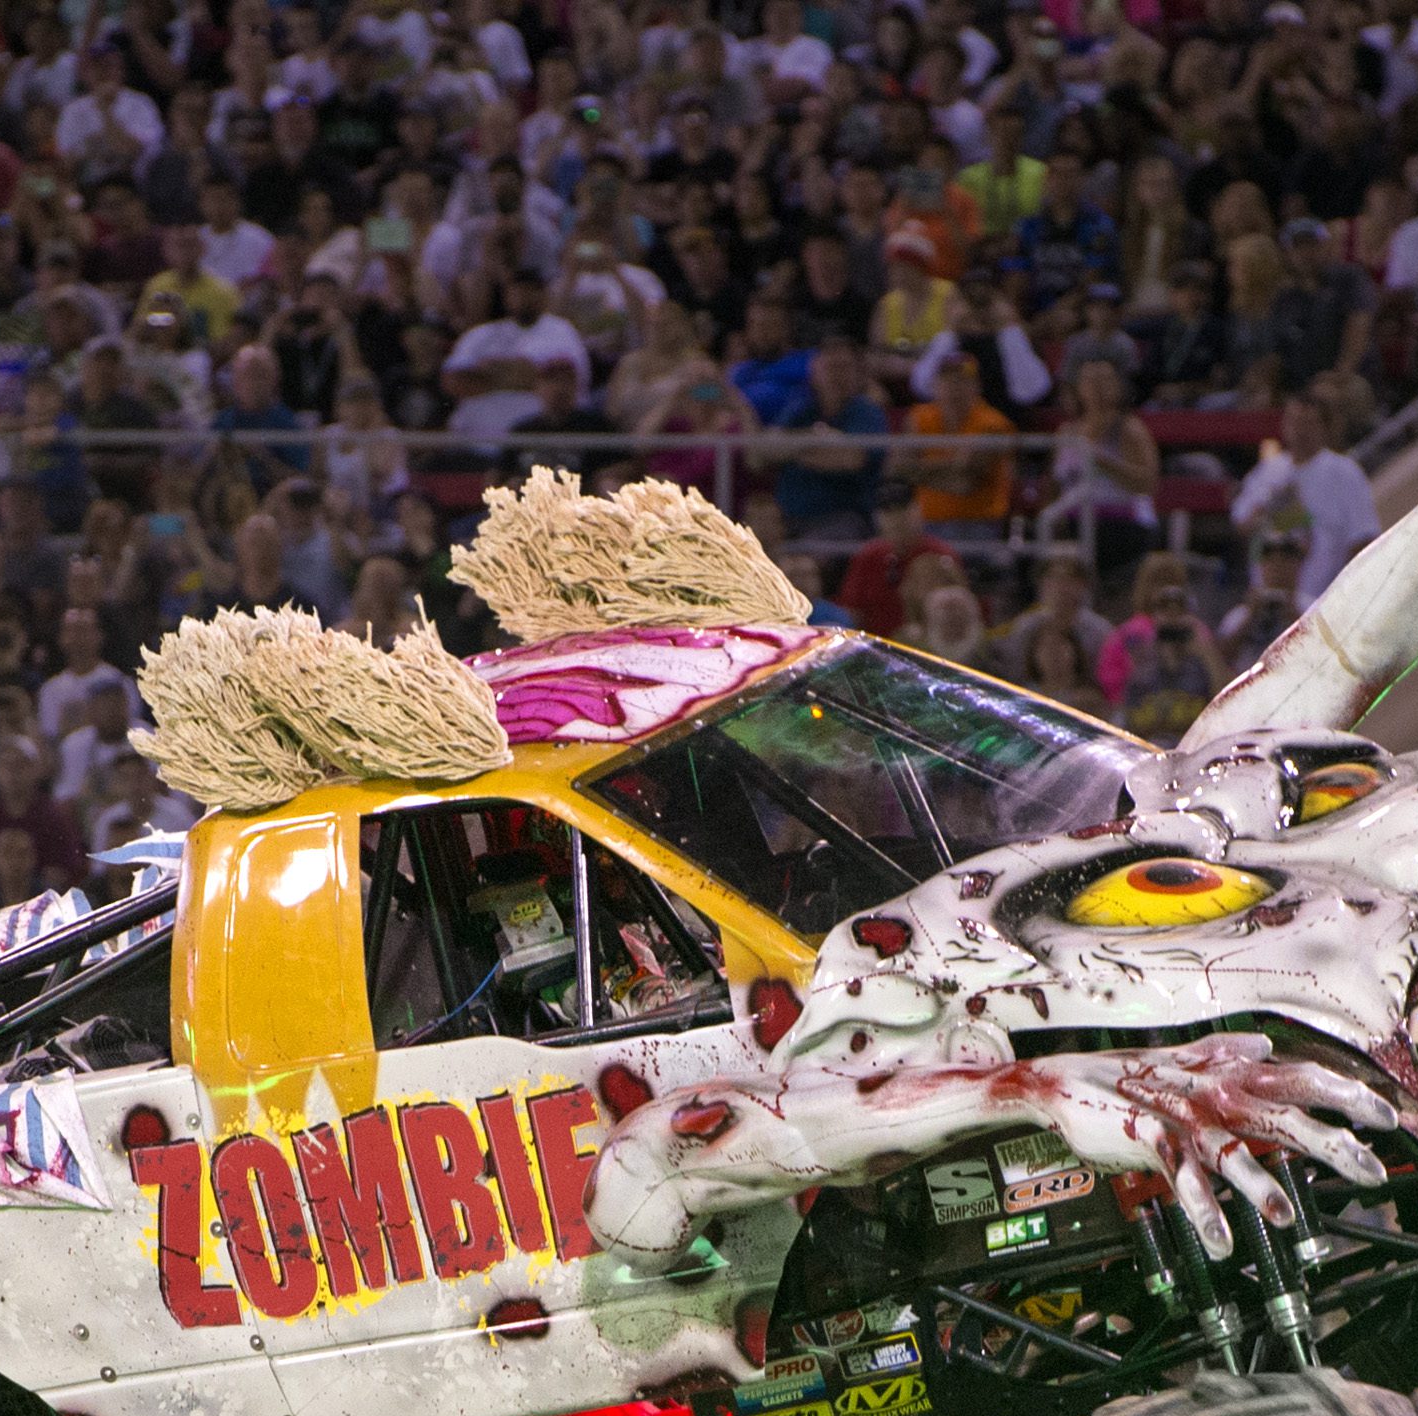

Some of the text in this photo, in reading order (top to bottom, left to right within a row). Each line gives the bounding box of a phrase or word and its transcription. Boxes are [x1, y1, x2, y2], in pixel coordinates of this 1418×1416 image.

[1008, 1171, 1092, 1202] CRD
[128, 1084, 604, 1330] ZOMBIE
[938, 1199, 996, 1223] SIMPSON
[987, 1216, 1045, 1244] BKT
